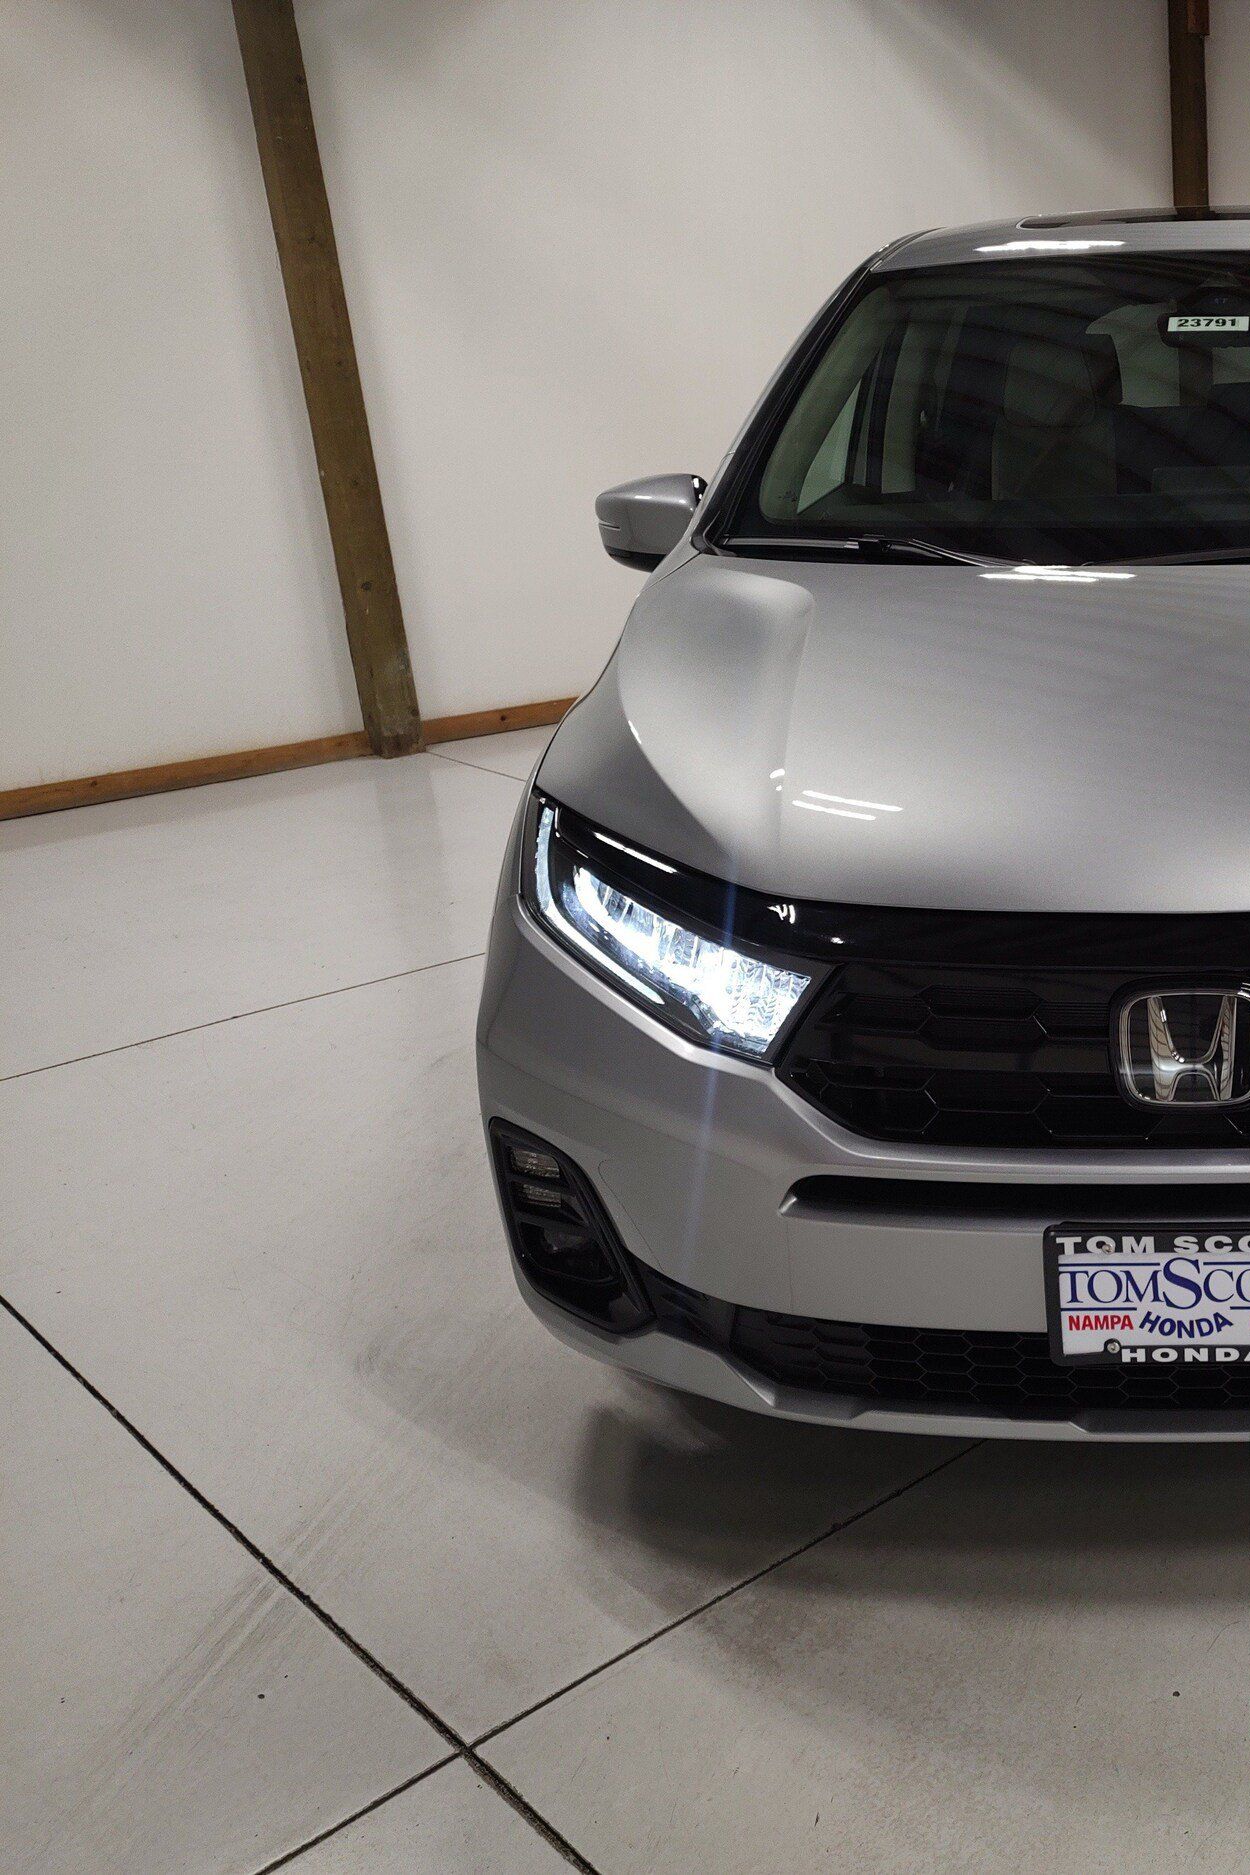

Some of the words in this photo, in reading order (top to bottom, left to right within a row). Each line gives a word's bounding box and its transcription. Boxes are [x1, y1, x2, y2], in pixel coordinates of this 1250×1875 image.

[1177, 318, 1237, 327] 23791
[1056, 1236, 1155, 1255] TOM
[1068, 1314, 1134, 1331] NAMPA
[1139, 1311, 1234, 1339] HONDA
